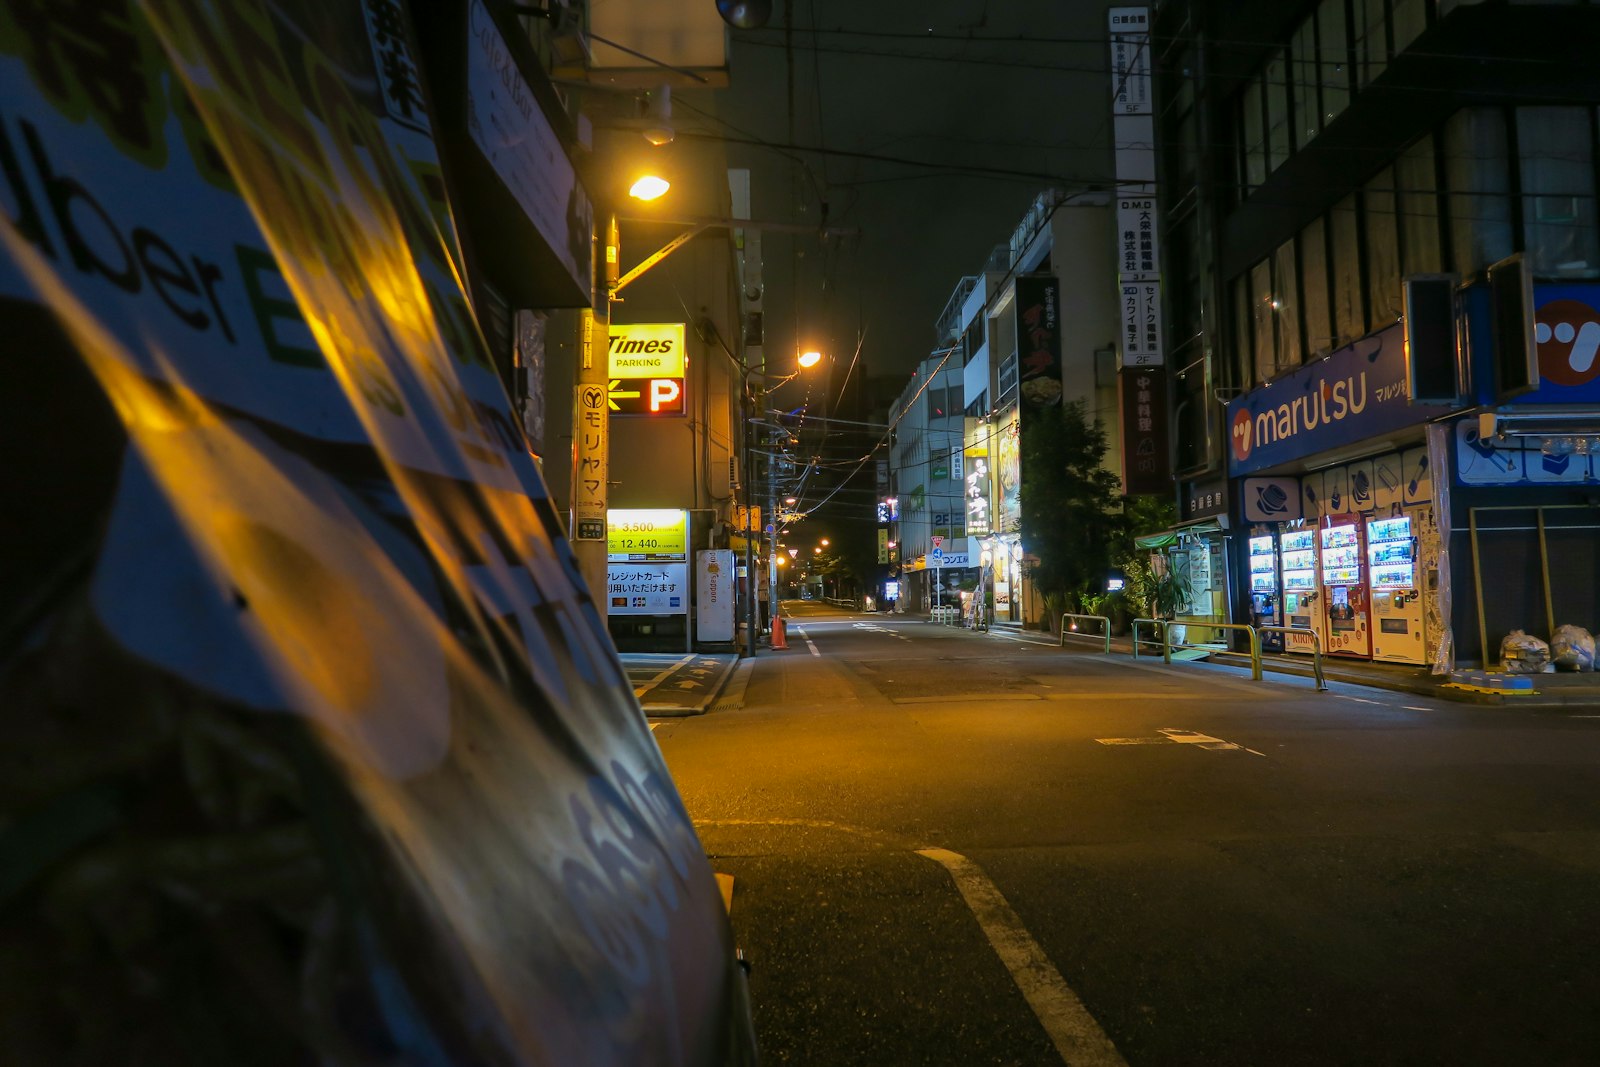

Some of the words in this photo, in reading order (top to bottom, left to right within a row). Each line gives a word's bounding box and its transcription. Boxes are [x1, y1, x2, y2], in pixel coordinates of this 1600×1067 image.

[1124, 231, 1137, 271] 株式会社
[608, 335, 674, 354] Times
[616, 358, 662, 368] PARKING
[651, 379, 680, 412] P
[581, 411, 601, 496] モリヤマ
[622, 522, 654, 533] 3,500
[935, 514, 950, 526] 2F
